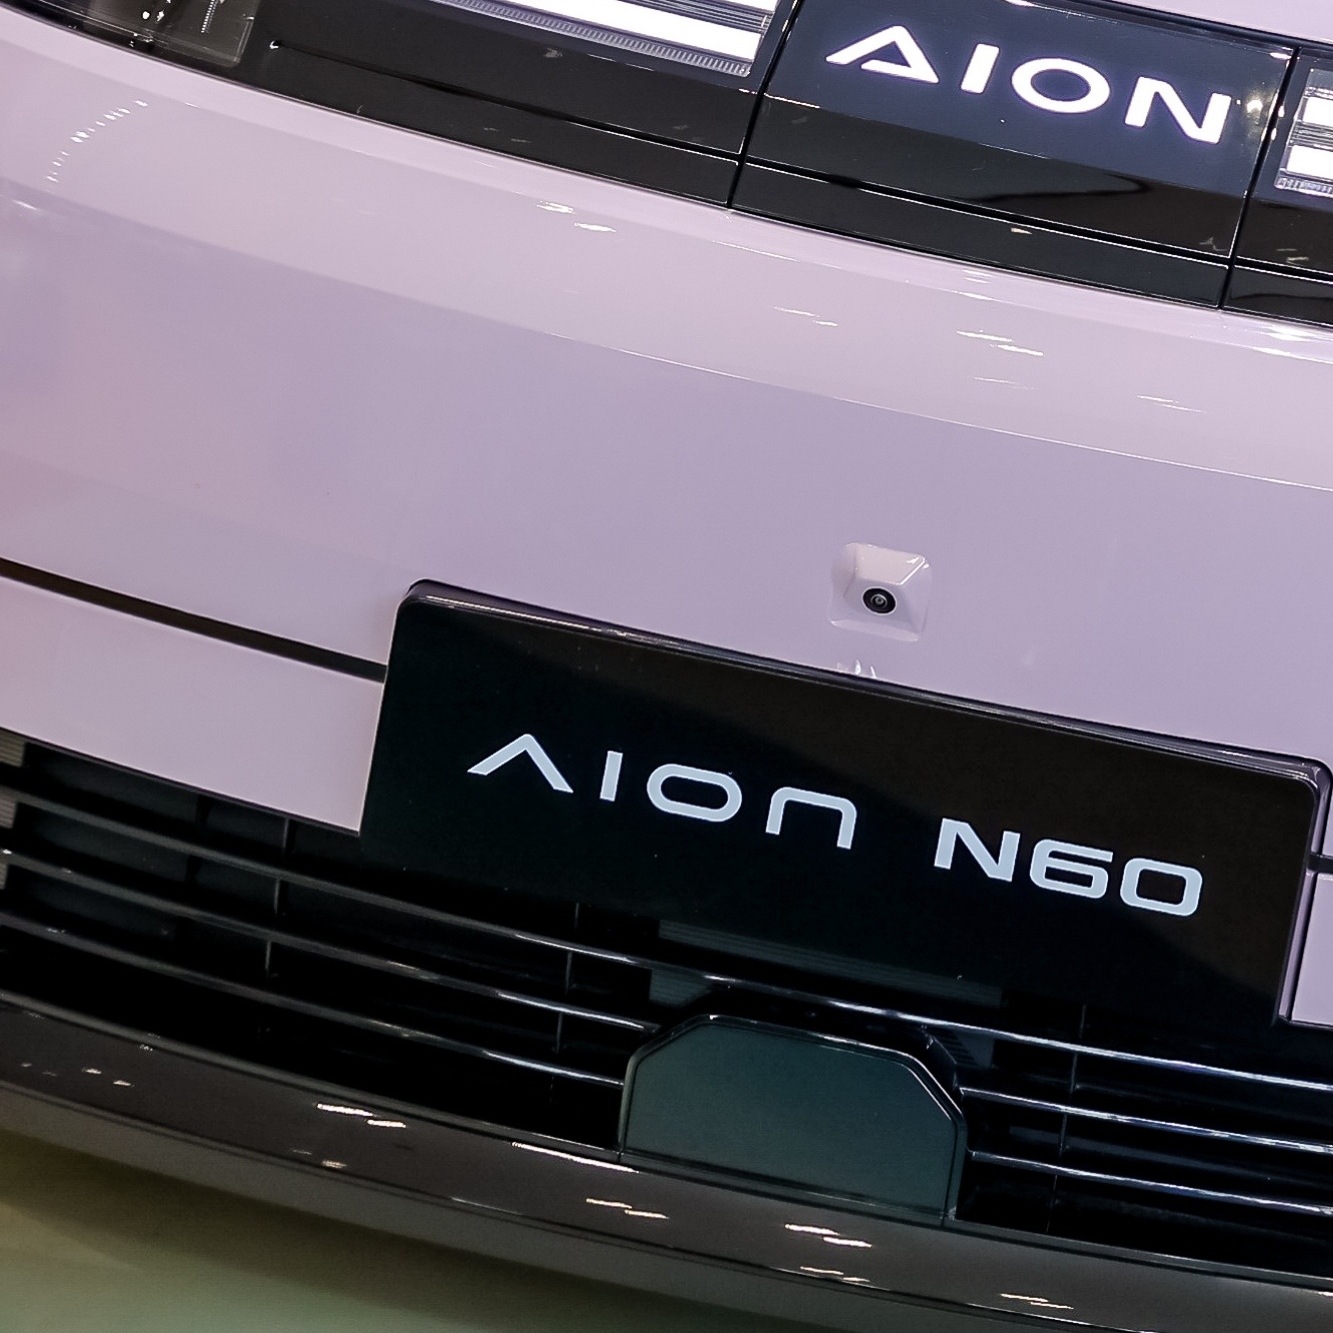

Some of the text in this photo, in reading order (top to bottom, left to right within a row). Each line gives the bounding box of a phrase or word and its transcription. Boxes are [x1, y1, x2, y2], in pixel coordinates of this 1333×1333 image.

[825, 25, 1232, 144] AION
[467, 733, 1203, 917] AION N60
